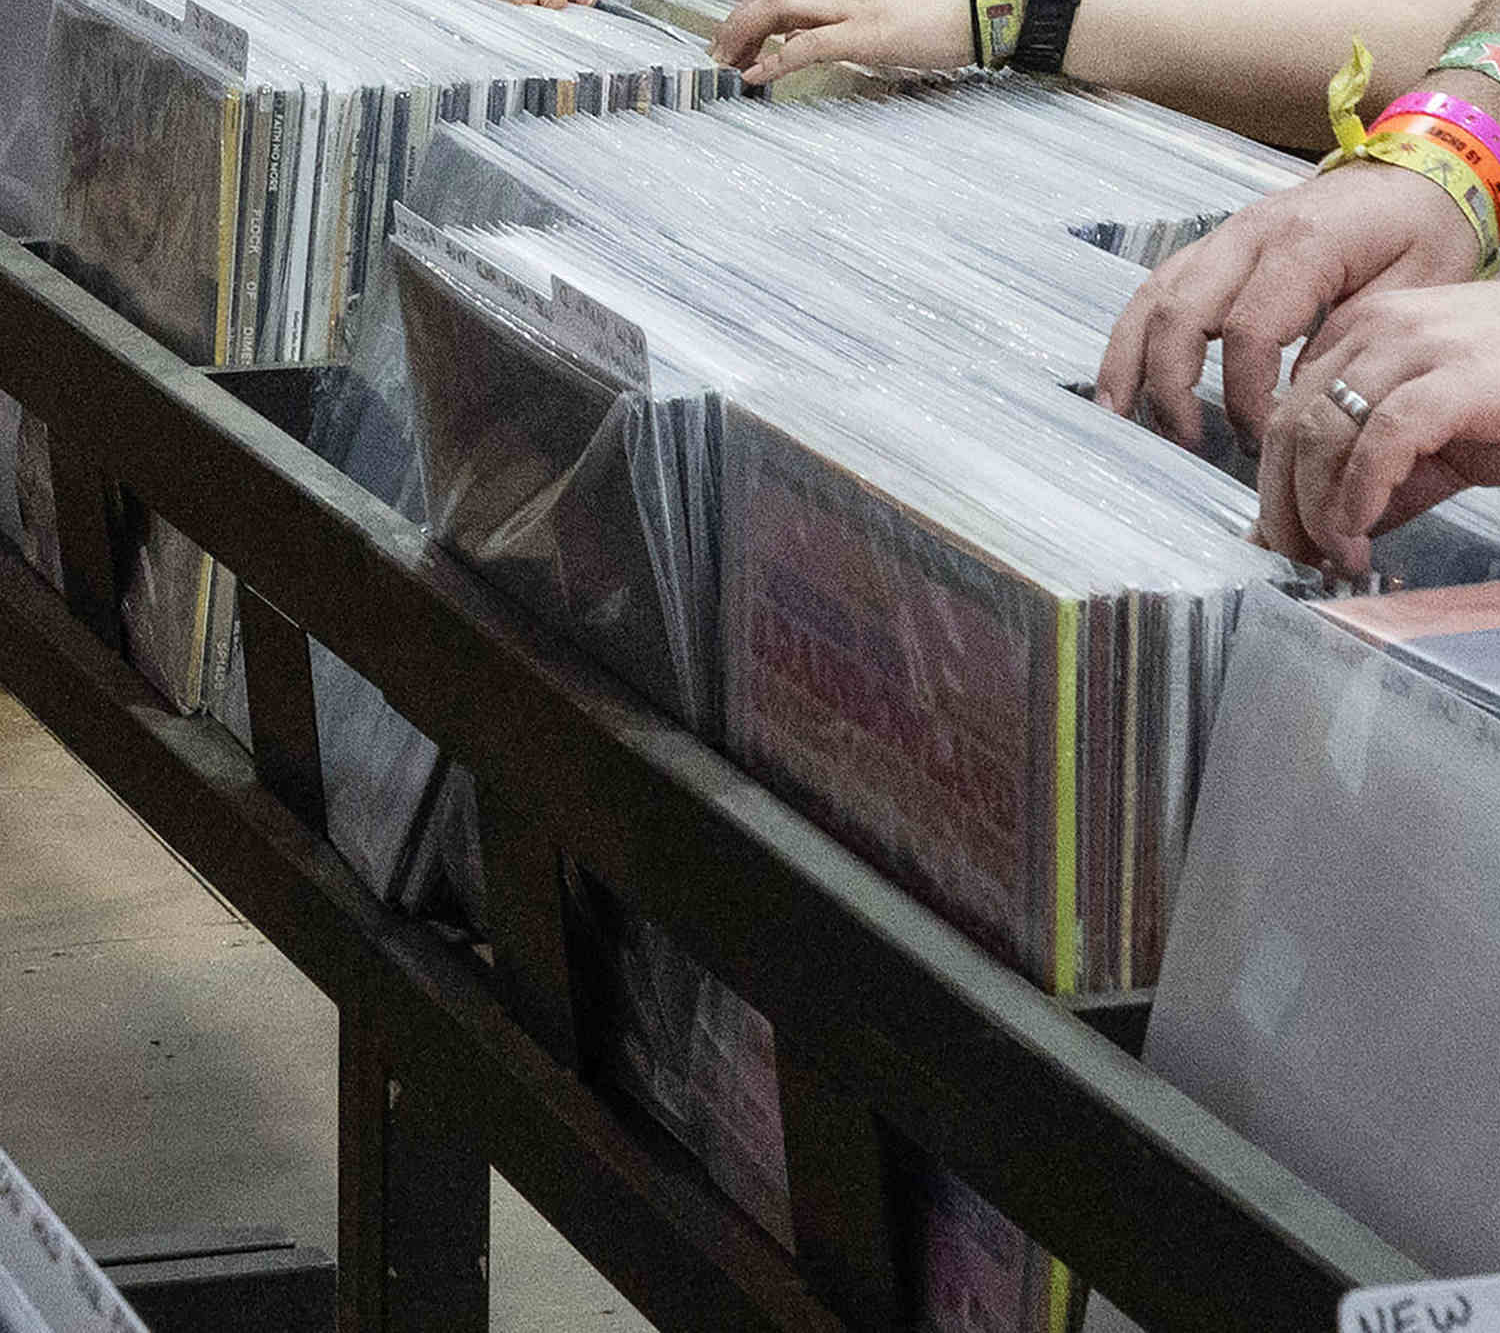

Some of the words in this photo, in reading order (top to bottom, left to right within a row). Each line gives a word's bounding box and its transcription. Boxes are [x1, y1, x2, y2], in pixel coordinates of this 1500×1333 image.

[272, 114, 284, 142] FAITH
[271, 144, 281, 160] NO
[268, 162, 279, 192] MORE
[247, 209, 260, 254] FLOCK
[245, 281, 257, 301] OF
[1357, 1294, 1474, 1333] NEW
